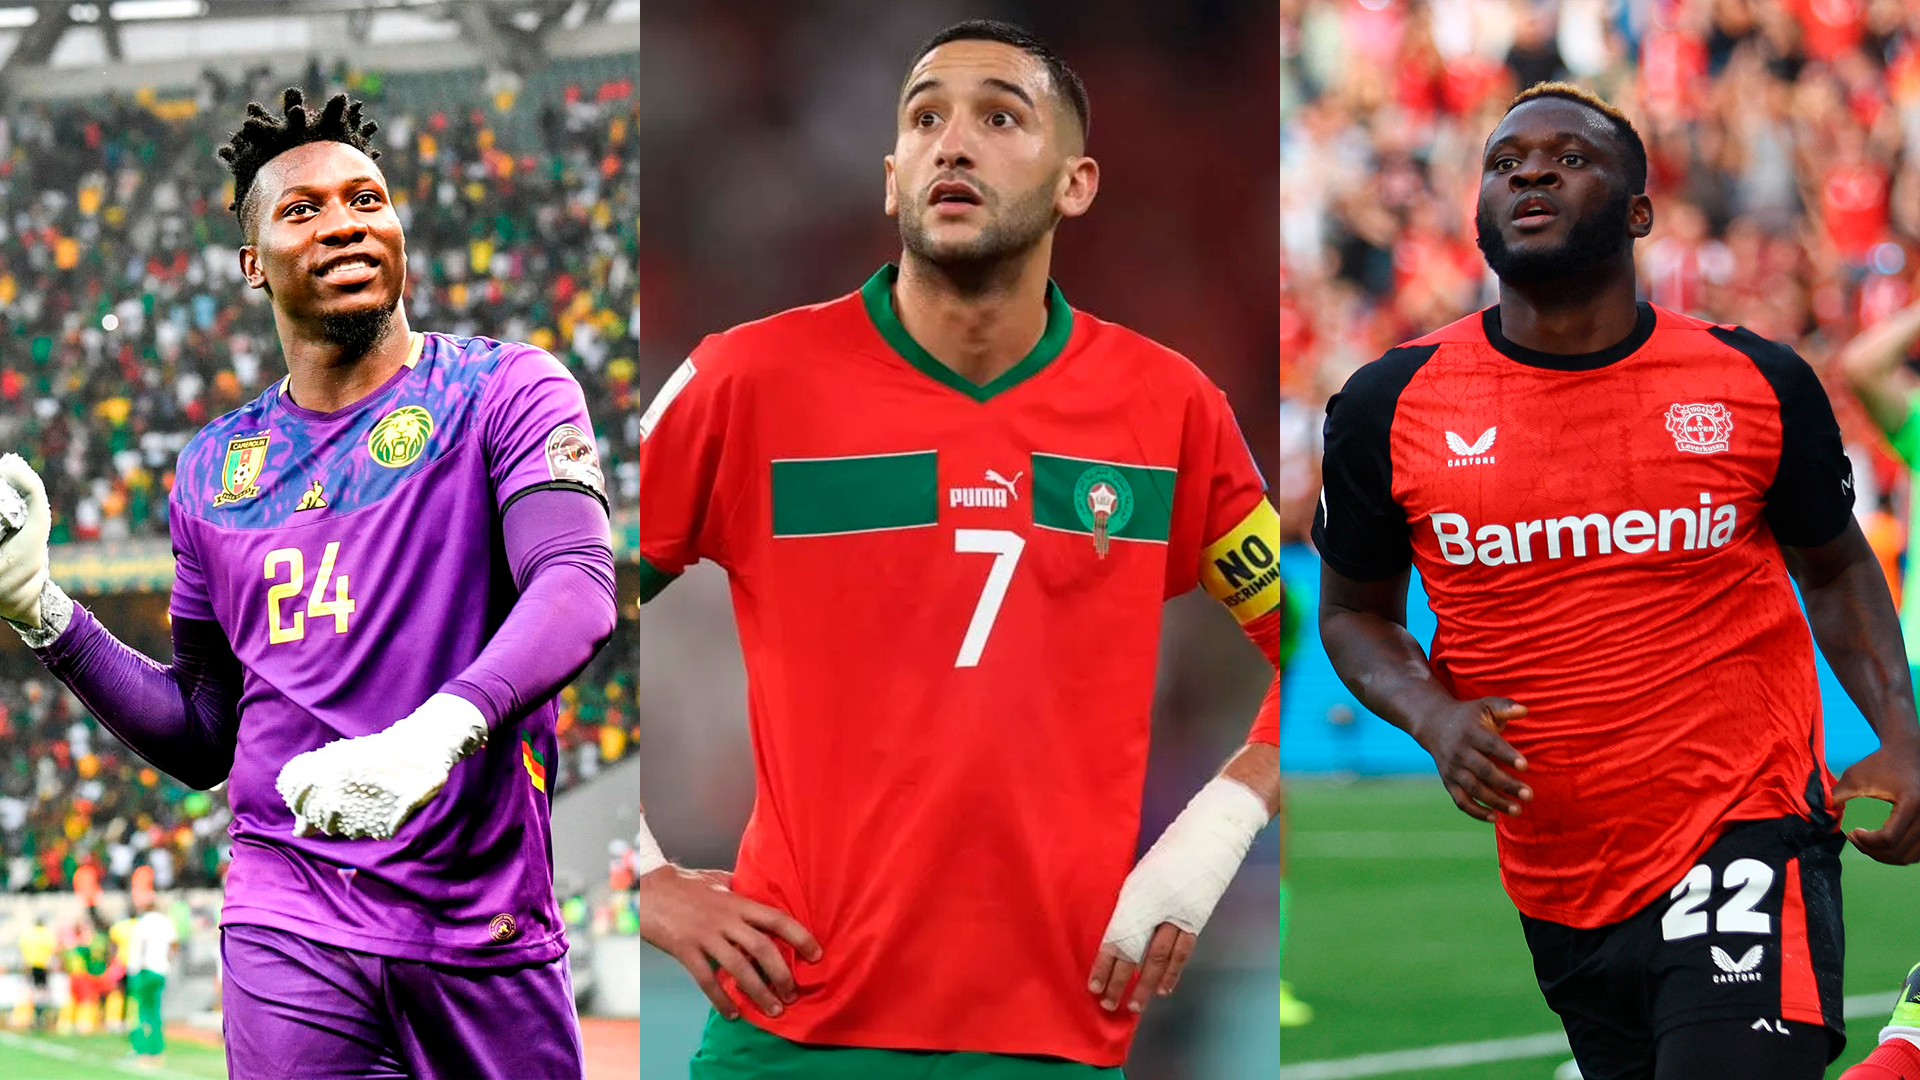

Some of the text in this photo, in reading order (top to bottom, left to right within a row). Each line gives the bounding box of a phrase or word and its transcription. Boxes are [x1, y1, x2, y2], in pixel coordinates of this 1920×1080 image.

[1447, 456, 1496, 468] CASTORE
[1681, 442, 1725, 452] Leverkusen
[950, 487, 1008, 508] PUMA
[1430, 492, 1738, 567] Barmenia
[1214, 534, 1274, 589] NO
[263, 541, 356, 645] 24
[954, 528, 1026, 668] 7
[1661, 858, 1774, 941] 22
[1712, 972, 1763, 984] CASTORE
